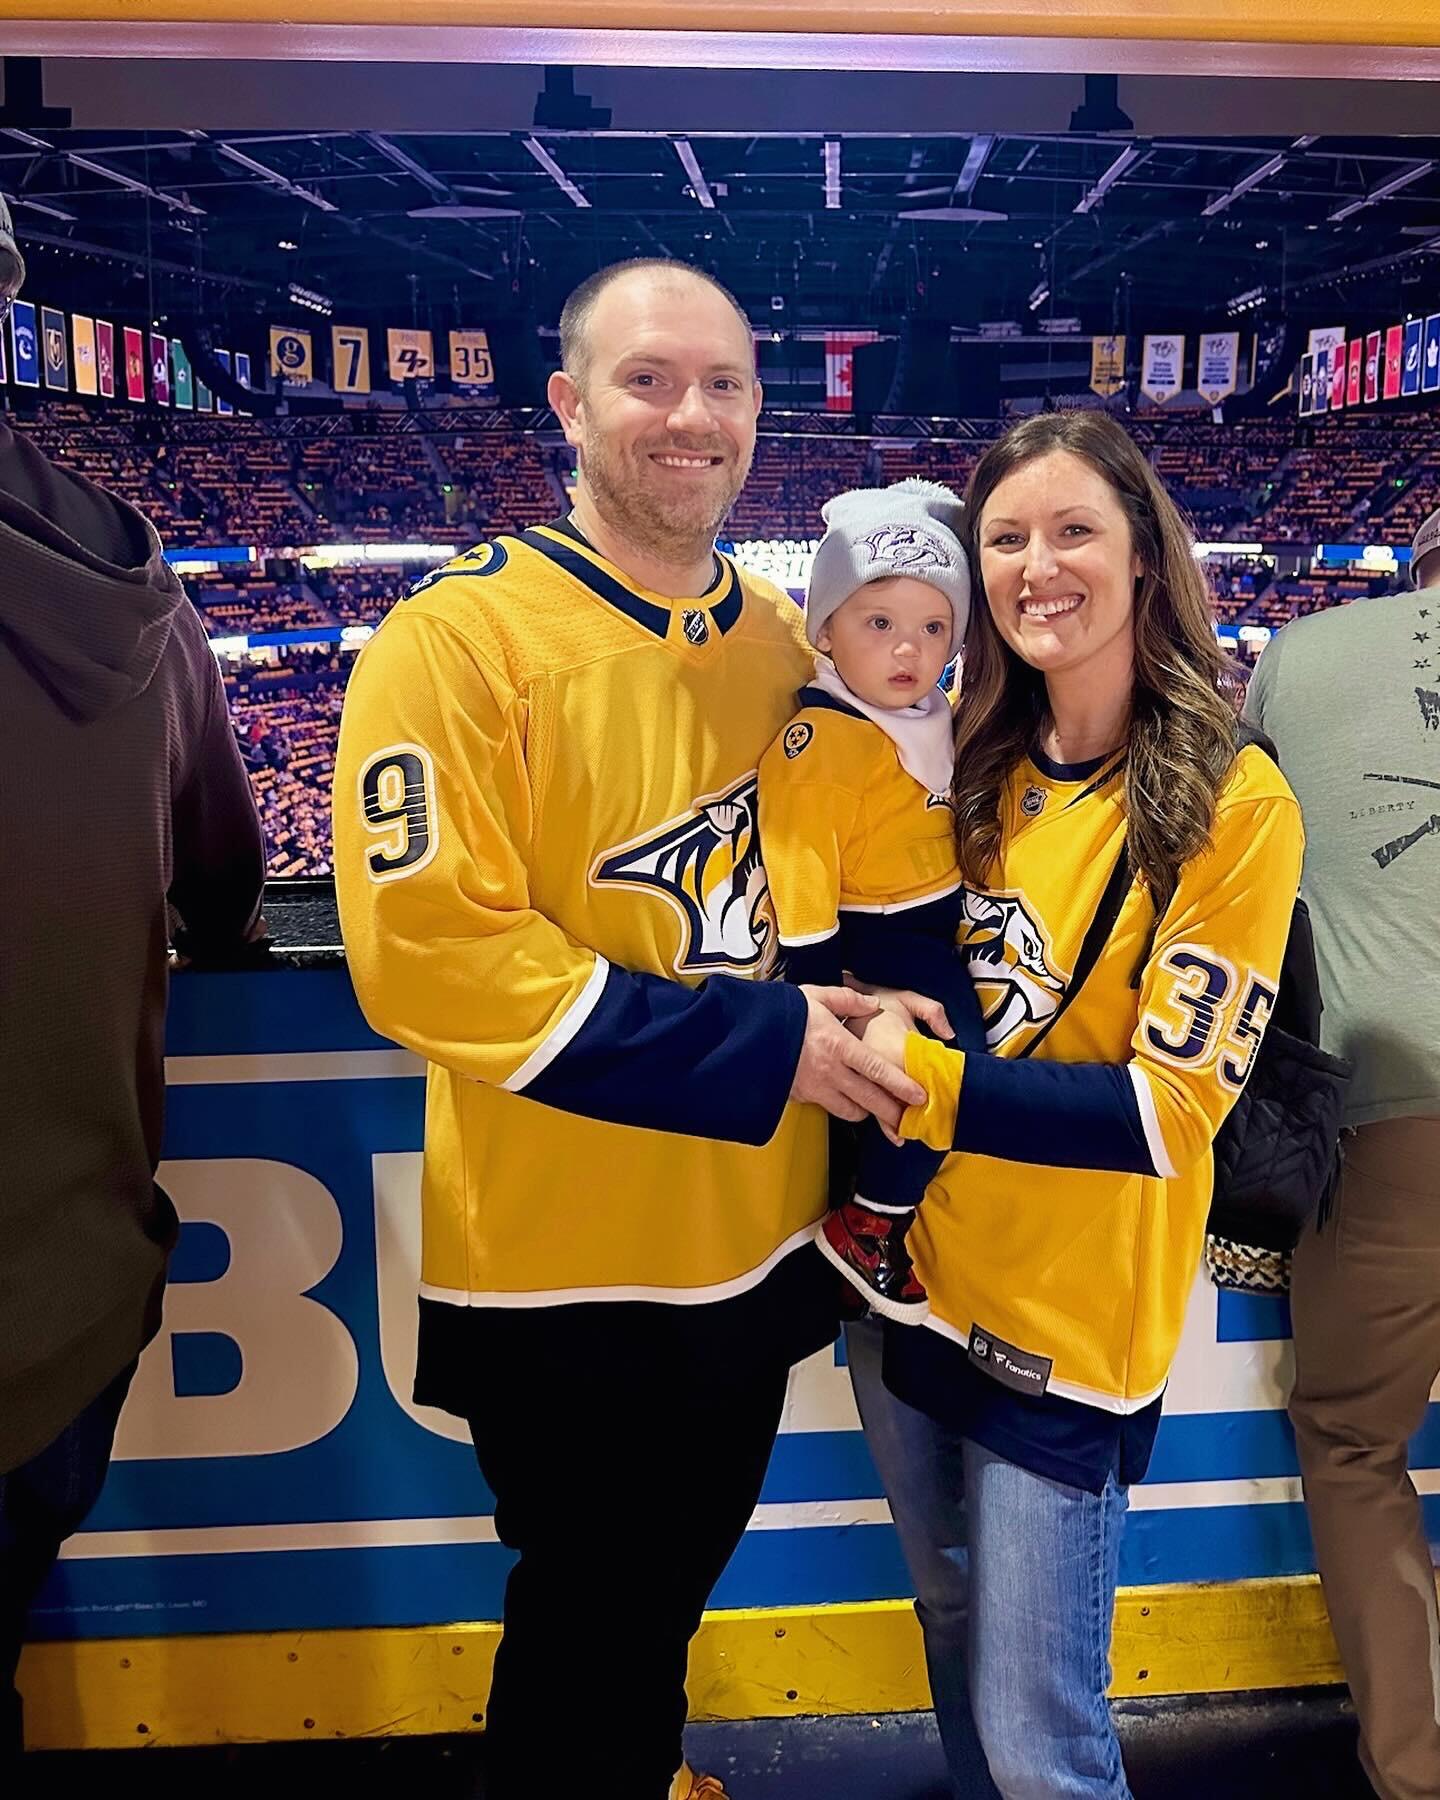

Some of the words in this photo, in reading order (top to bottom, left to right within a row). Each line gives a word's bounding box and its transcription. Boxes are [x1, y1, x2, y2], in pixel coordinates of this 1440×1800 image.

[338, 336, 363, 388] 7
[454, 347, 489, 378] 35
[358, 743, 439, 884] 9
[1349, 800, 1415, 820] LIBERTY
[1140, 942, 1279, 1094] 35
[1005, 1359, 1042, 1381] Fanatics
